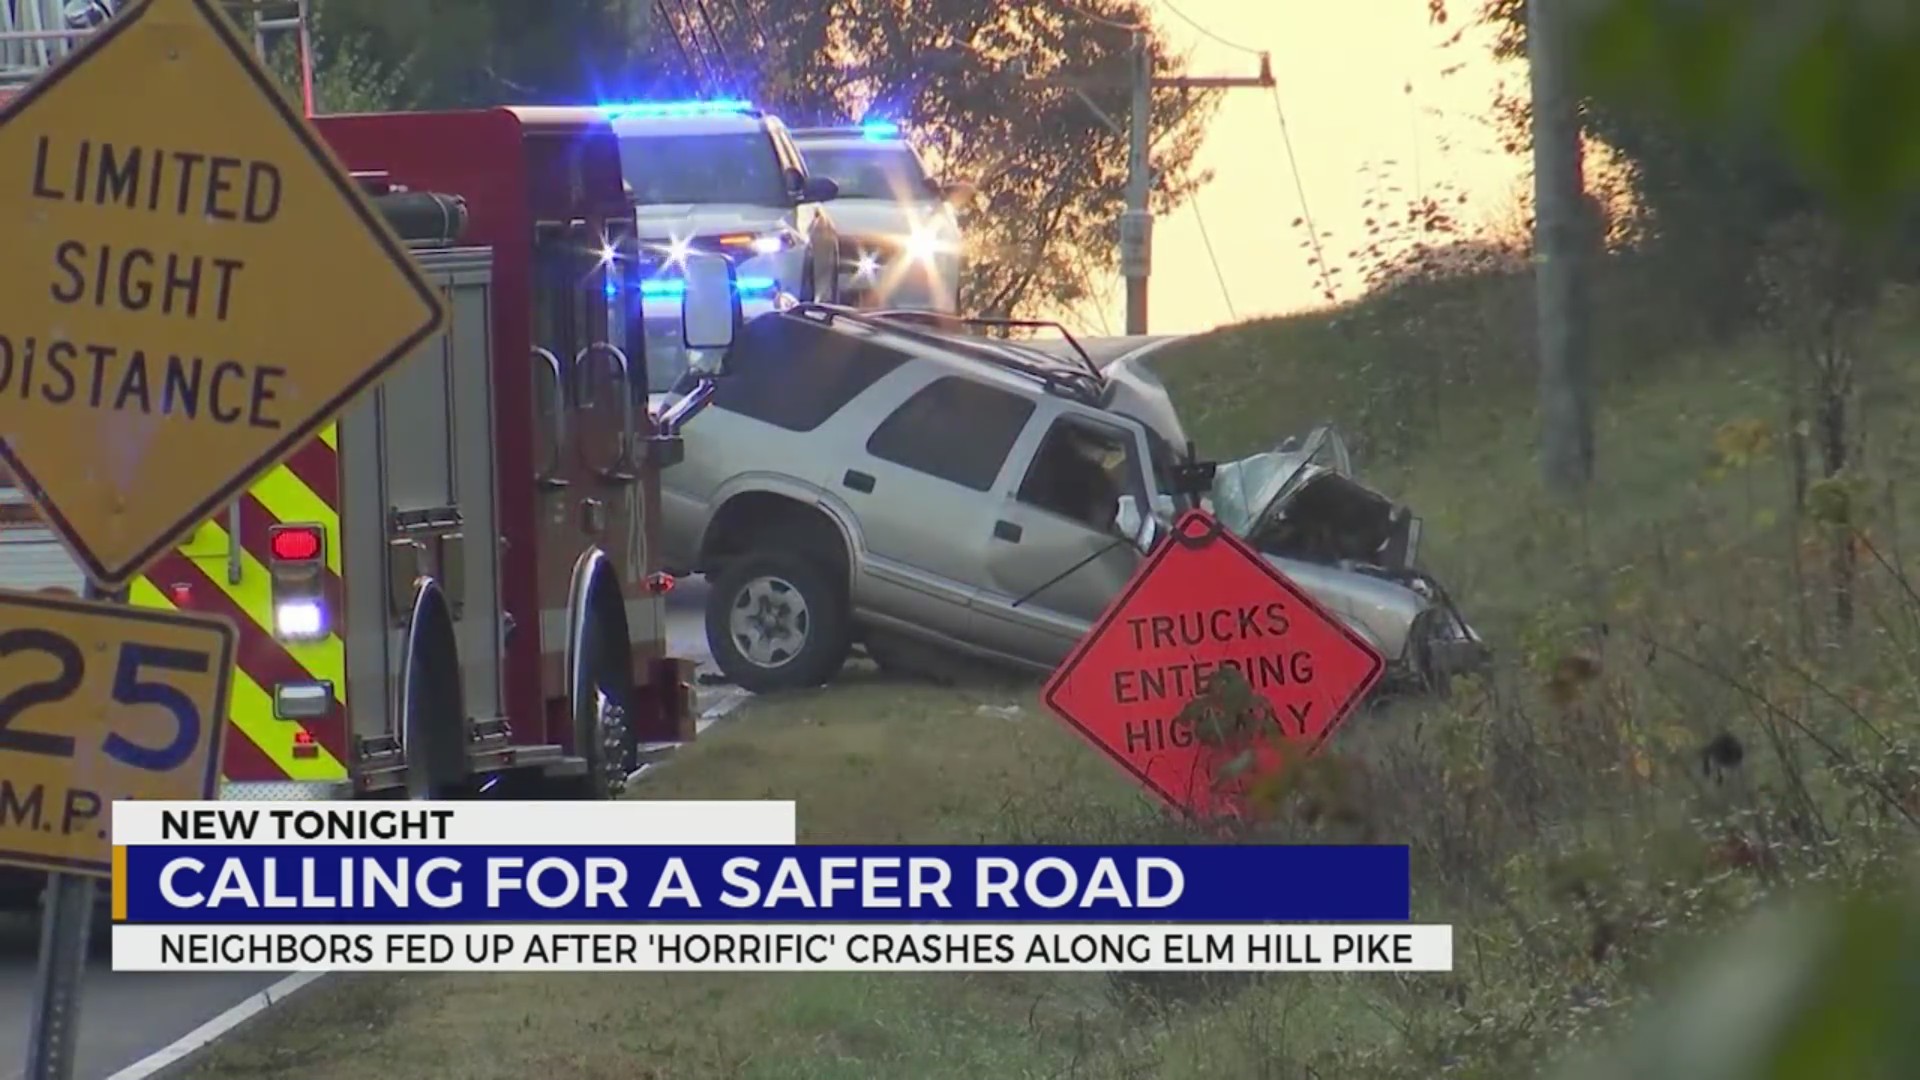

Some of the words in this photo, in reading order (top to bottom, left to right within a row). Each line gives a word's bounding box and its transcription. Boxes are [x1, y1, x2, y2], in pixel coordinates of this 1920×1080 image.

[32, 136, 282, 224] LIMITED
[51, 240, 244, 321] SIGHT
[1127, 603, 1290, 650] TRUCKS
[0, 628, 209, 772] 25
